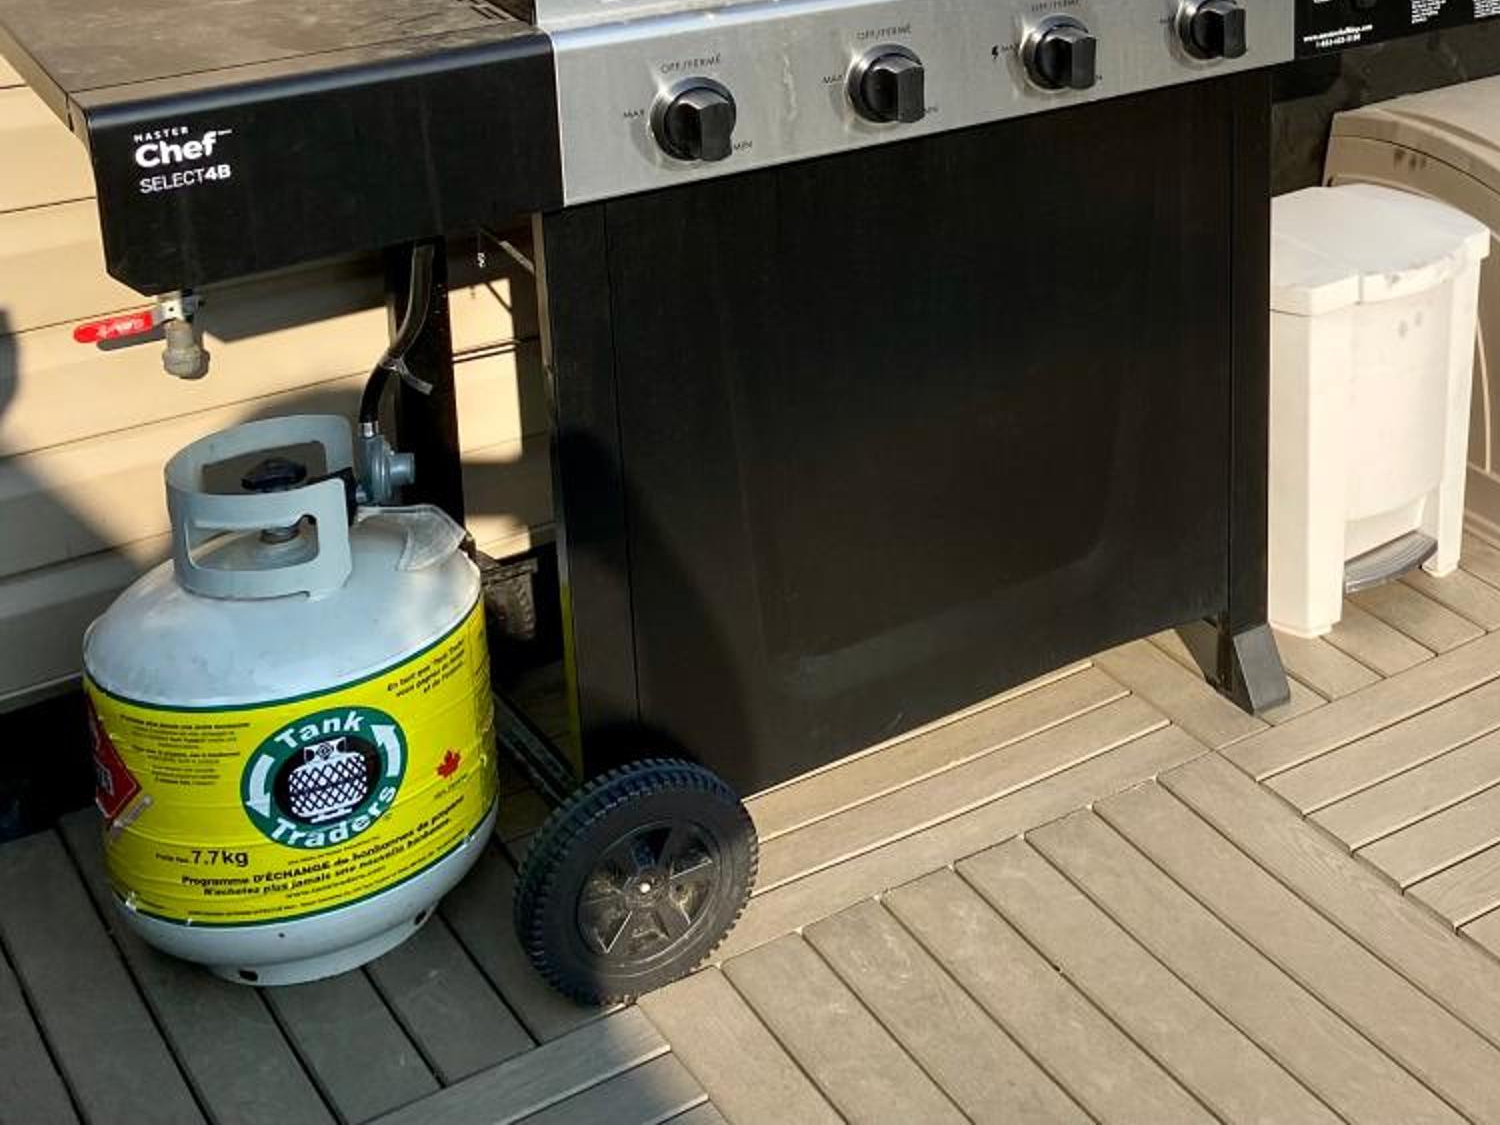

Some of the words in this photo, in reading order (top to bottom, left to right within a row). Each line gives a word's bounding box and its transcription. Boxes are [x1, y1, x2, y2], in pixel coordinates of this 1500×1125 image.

[133, 126, 189, 143] MASTER
[135, 131, 217, 168] Chef
[274, 710, 365, 749] Tank
[270, 786, 397, 848] Traders
[181, 875, 249, 887] Programme
[252, 860, 331, 883] D'ÉCHANGE
[334, 857, 350, 867] de
[263, 882, 289, 895] plus
[290, 872, 331, 890] jamais
[335, 865, 356, 877] une
